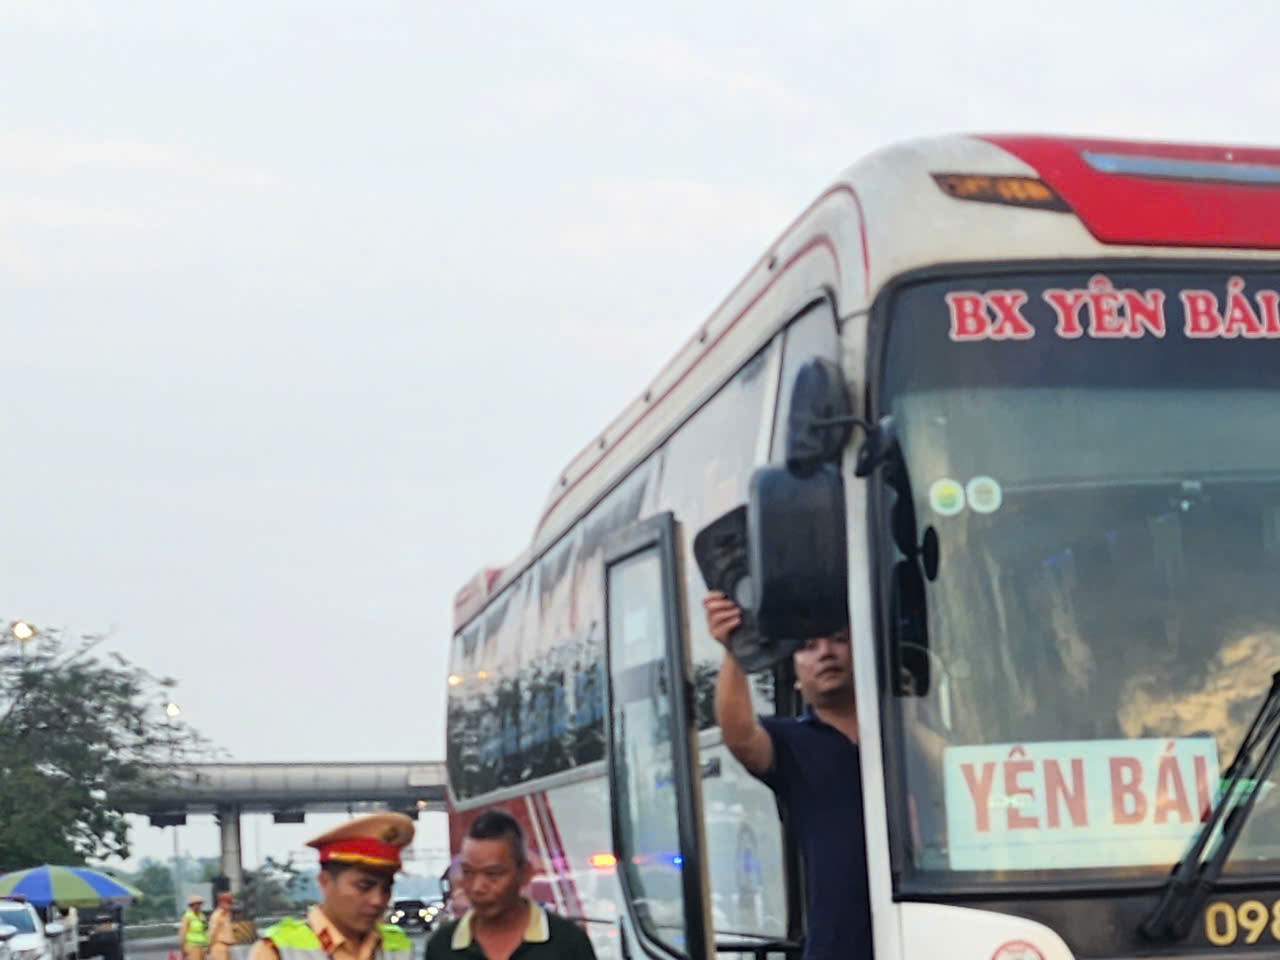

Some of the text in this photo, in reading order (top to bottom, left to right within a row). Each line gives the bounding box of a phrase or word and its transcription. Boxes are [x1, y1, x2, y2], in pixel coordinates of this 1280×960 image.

[945, 291, 1035, 341] BX
[1042, 274, 1165, 338] YÊN
[960, 740, 1213, 833] YÊN BÁI
